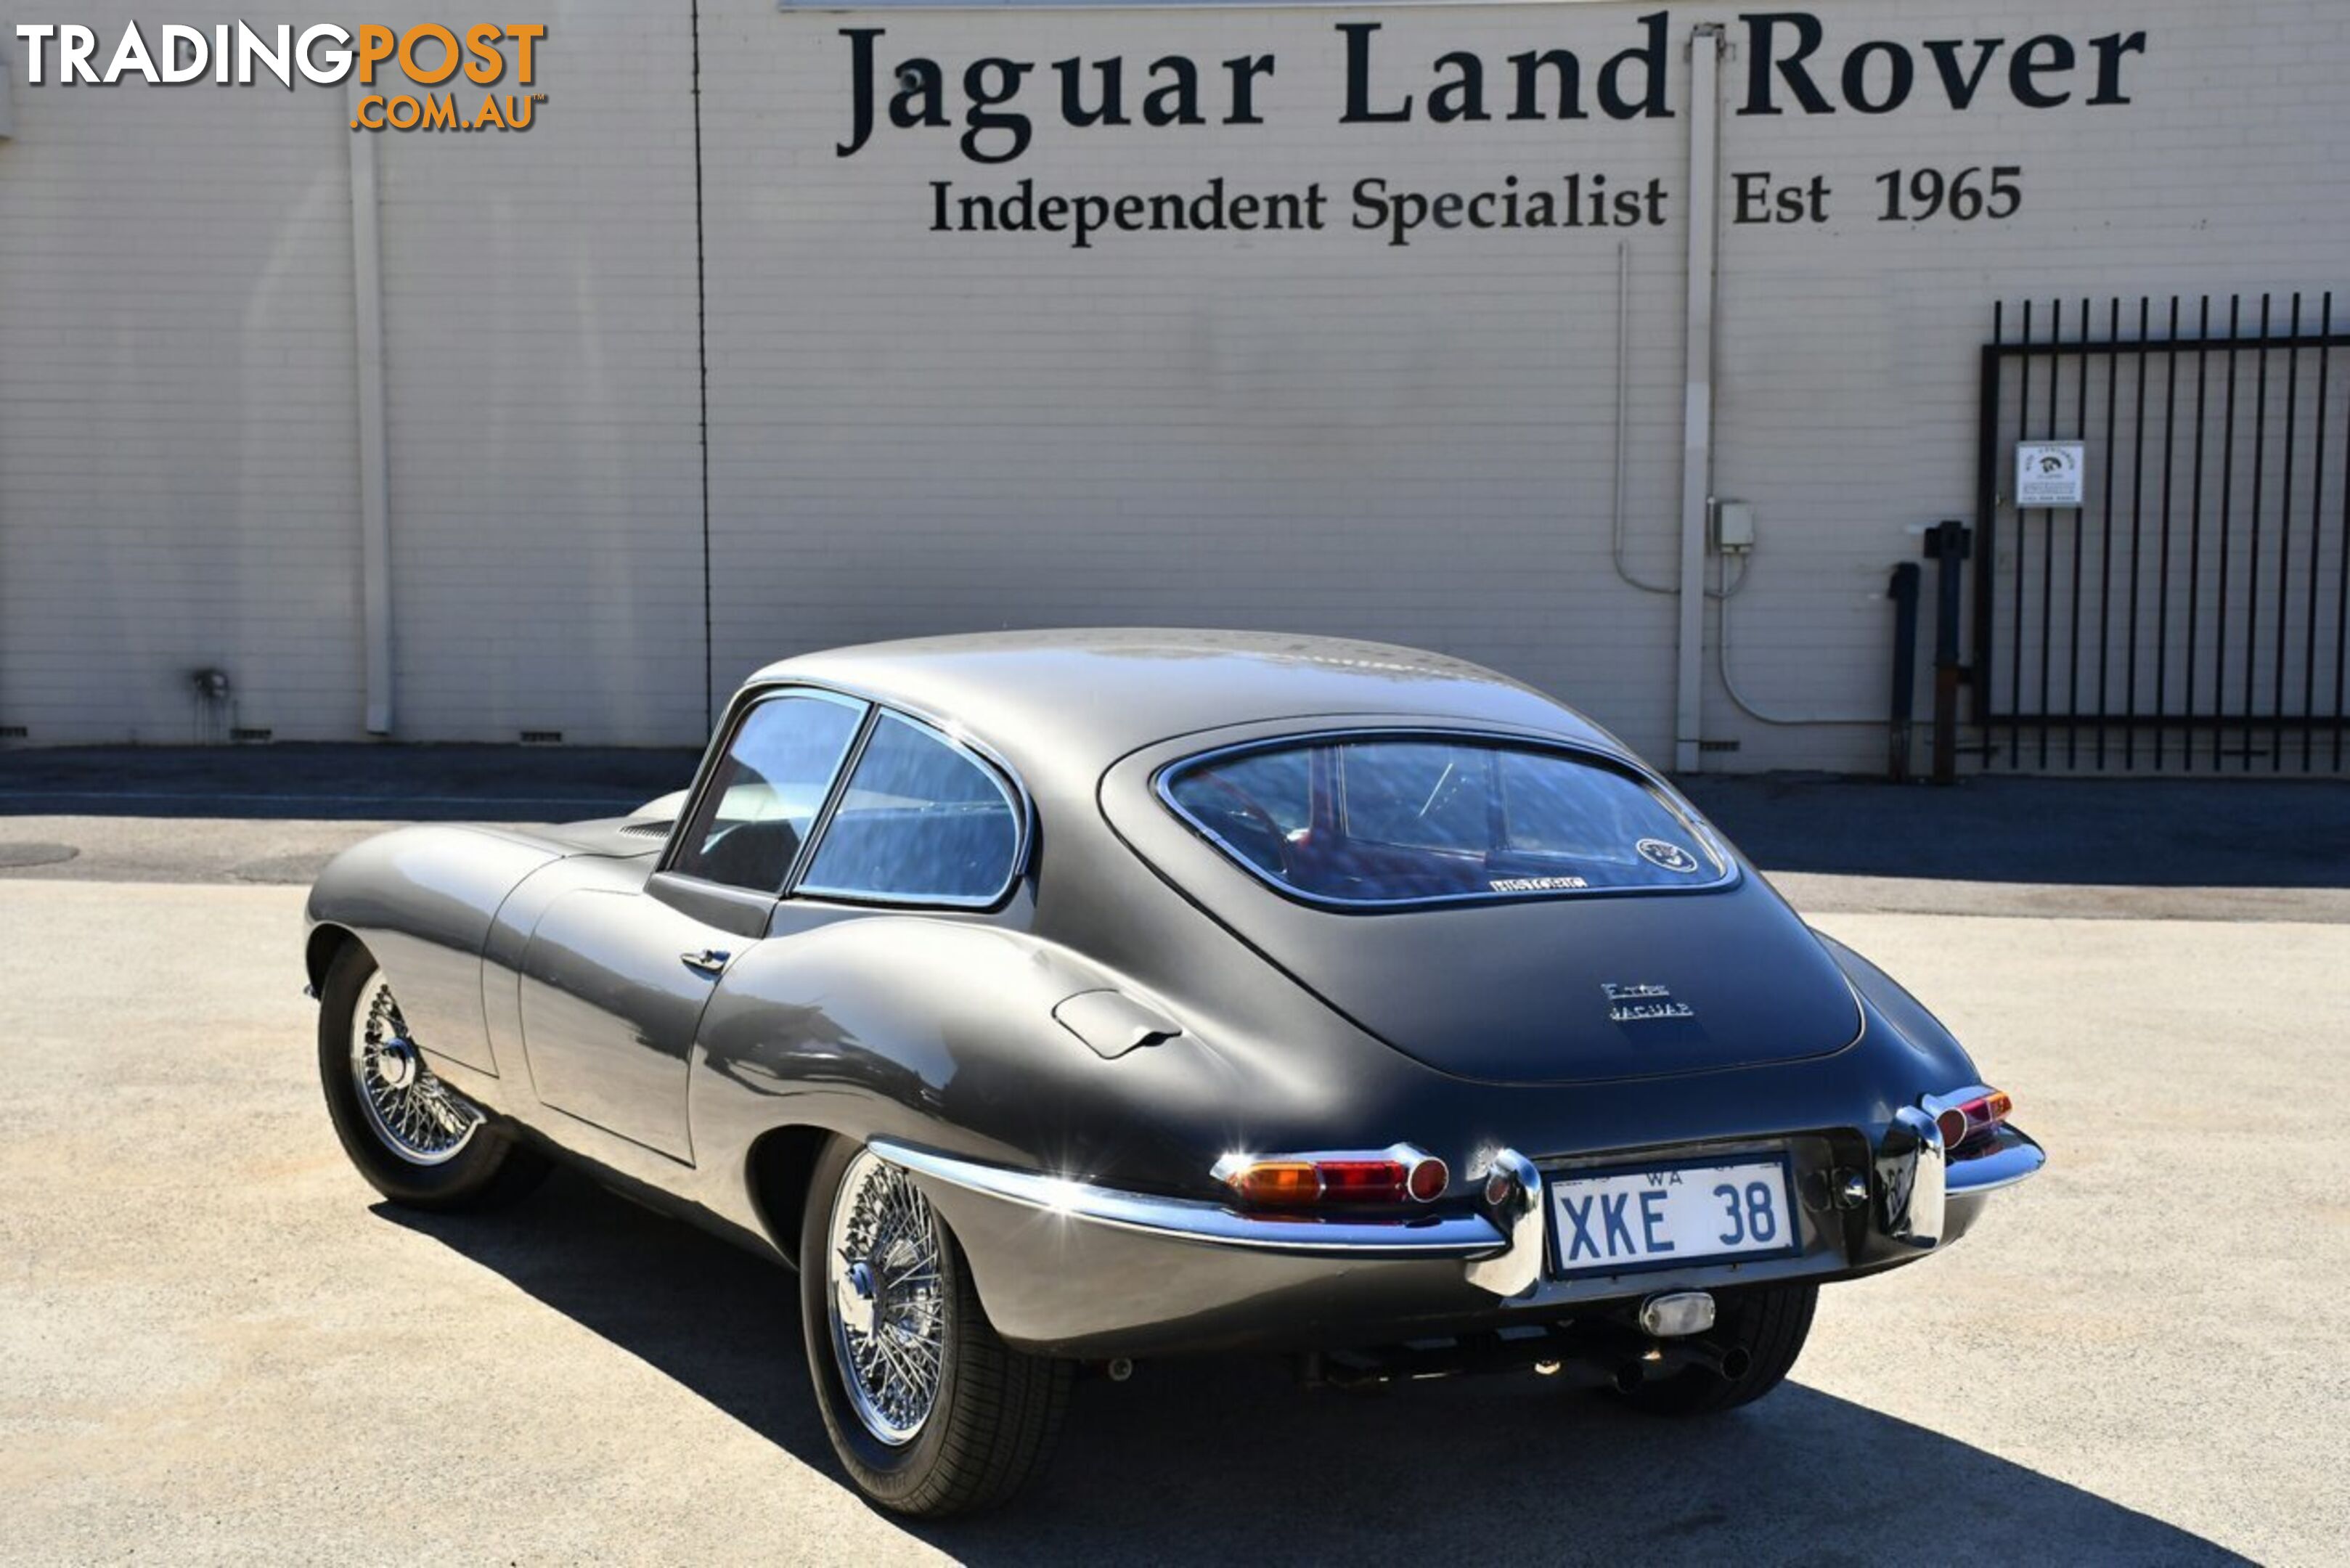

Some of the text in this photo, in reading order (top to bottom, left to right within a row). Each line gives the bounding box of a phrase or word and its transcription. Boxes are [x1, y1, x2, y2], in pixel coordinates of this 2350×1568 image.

[836, 10, 2147, 164] Jaguar Land Rover
[929, 166, 2021, 248] Independent Specialist Est 1965
[1646, 1170, 1683, 1186] WA
[1560, 1181, 1776, 1261] XKE 38
